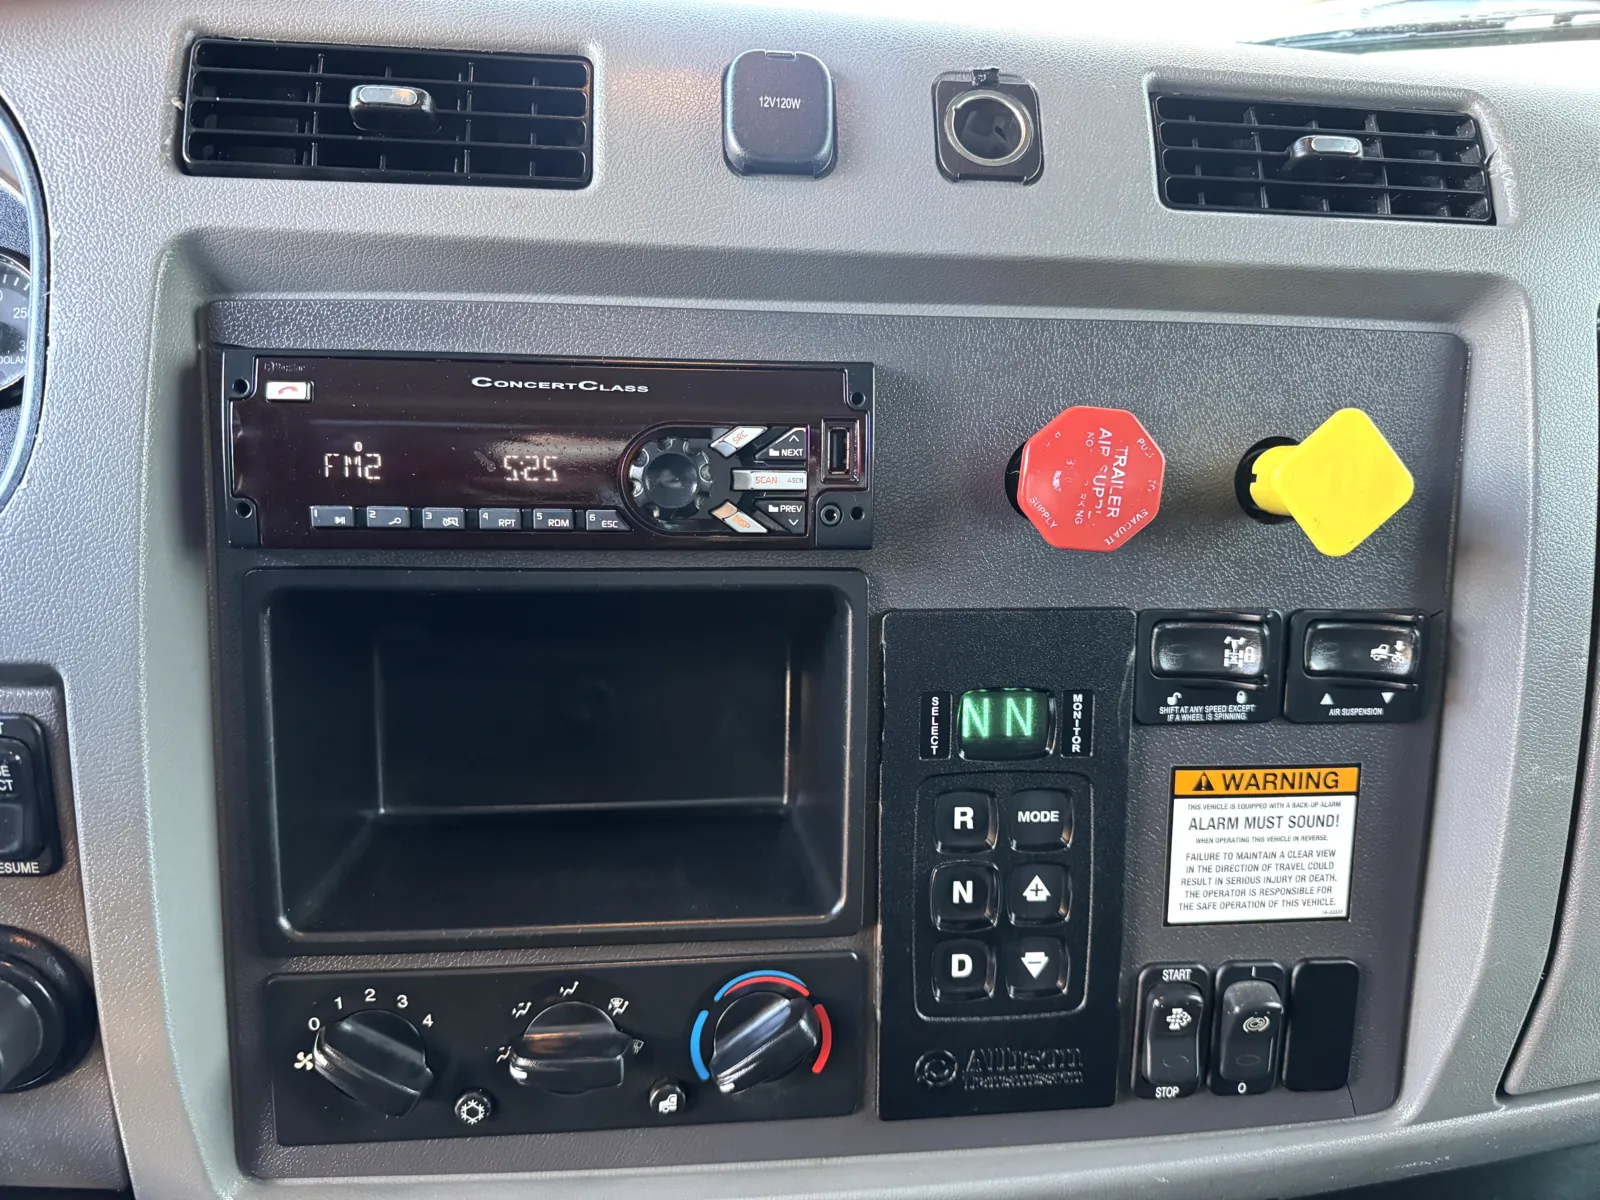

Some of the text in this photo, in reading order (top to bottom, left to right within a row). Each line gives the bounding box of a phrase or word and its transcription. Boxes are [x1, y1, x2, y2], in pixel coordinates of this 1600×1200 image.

[758, 96, 801, 110] 12V120W
[732, 430, 748, 445] SRC
[324, 454, 382, 480] FM2
[504, 455, 558, 481] 5:25
[1106, 446, 1128, 518] TRAILER
[314, 510, 318, 518] 1
[368, 510, 376, 518] 2
[482, 512, 489, 520] 4
[589, 514, 596, 522] 6
[1030, 497, 1057, 528] SUPPLY
[499, 518, 515, 527] RPT
[548, 518, 569, 527] RDM
[602, 520, 618, 528] ESC
[733, 515, 750, 528] DISP
[1159, 706, 1179, 714] SHIFT
[1204, 705, 1227, 713] SPEED
[1229, 704, 1256, 712] EXCEPT
[1329, 708, 1384, 716] AIR SUSPENSION
[1206, 713, 1212, 721] IS
[931, 696, 939, 755] SELECT
[1072, 694, 1082, 753] MONITOR
[1221, 771, 1339, 791] WARNING
[954, 807, 974, 829] R
[1018, 811, 1060, 822] MODE
[1188, 814, 1339, 830] ALARM MUST SOUND!
[1186, 852, 1220, 861] FAILURE
[1223, 852, 1233, 860] TO
[1236, 851, 1276, 860] MAINTAIN
[1287, 850, 1314, 858] CLEAR
[1316, 849, 1336, 858] VIEW
[1186, 865, 1194, 874] IN
[1197, 865, 1213, 873] THE
[1215, 864, 1259, 873] DIRECTION
[1275, 863, 1305, 871] TRAVEL
[1308, 862, 1334, 870] COULD
[1181, 874, 1337, 886] RESULT IN SERIOUS INJURY OR DEATH.
[952, 880, 973, 903] N
[1185, 886, 1332, 898] THE OPERATOR IS RESPONSIBLE FOR
[1179, 898, 1336, 910] THE SAFE OPERATION OF THIS VEHICLE.
[951, 954, 973, 978] D
[1162, 969, 1191, 981] START
[364, 988, 376, 1002] 2
[334, 997, 342, 1010] 1
[396, 995, 408, 1008] 3
[422, 1014, 433, 1027] 4
[1156, 1087, 1179, 1098] STOP
